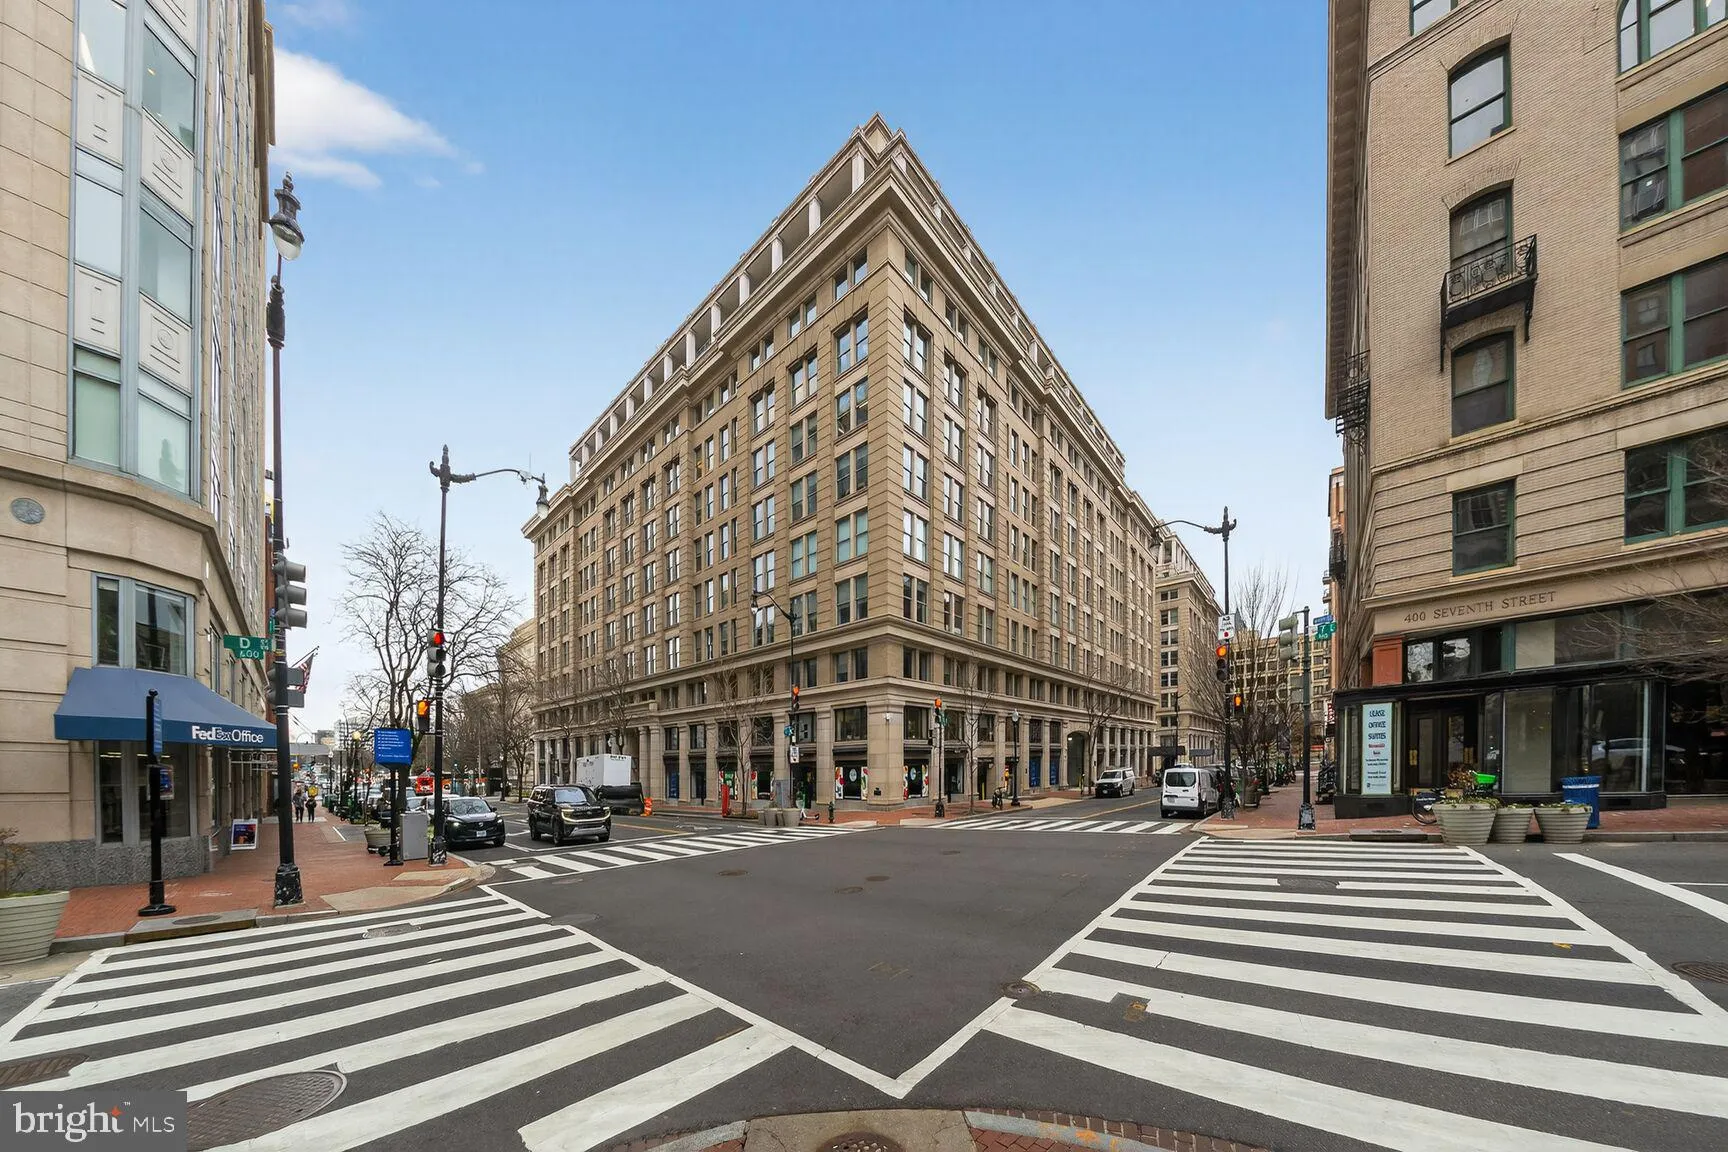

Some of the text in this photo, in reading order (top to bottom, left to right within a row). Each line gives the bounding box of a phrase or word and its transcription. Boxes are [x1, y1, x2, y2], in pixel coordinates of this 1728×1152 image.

[1404, 591, 1557, 624] 400 SEVENTH STREET
[239, 637, 251, 649] D
[191, 725, 264, 743] FedEx Office
